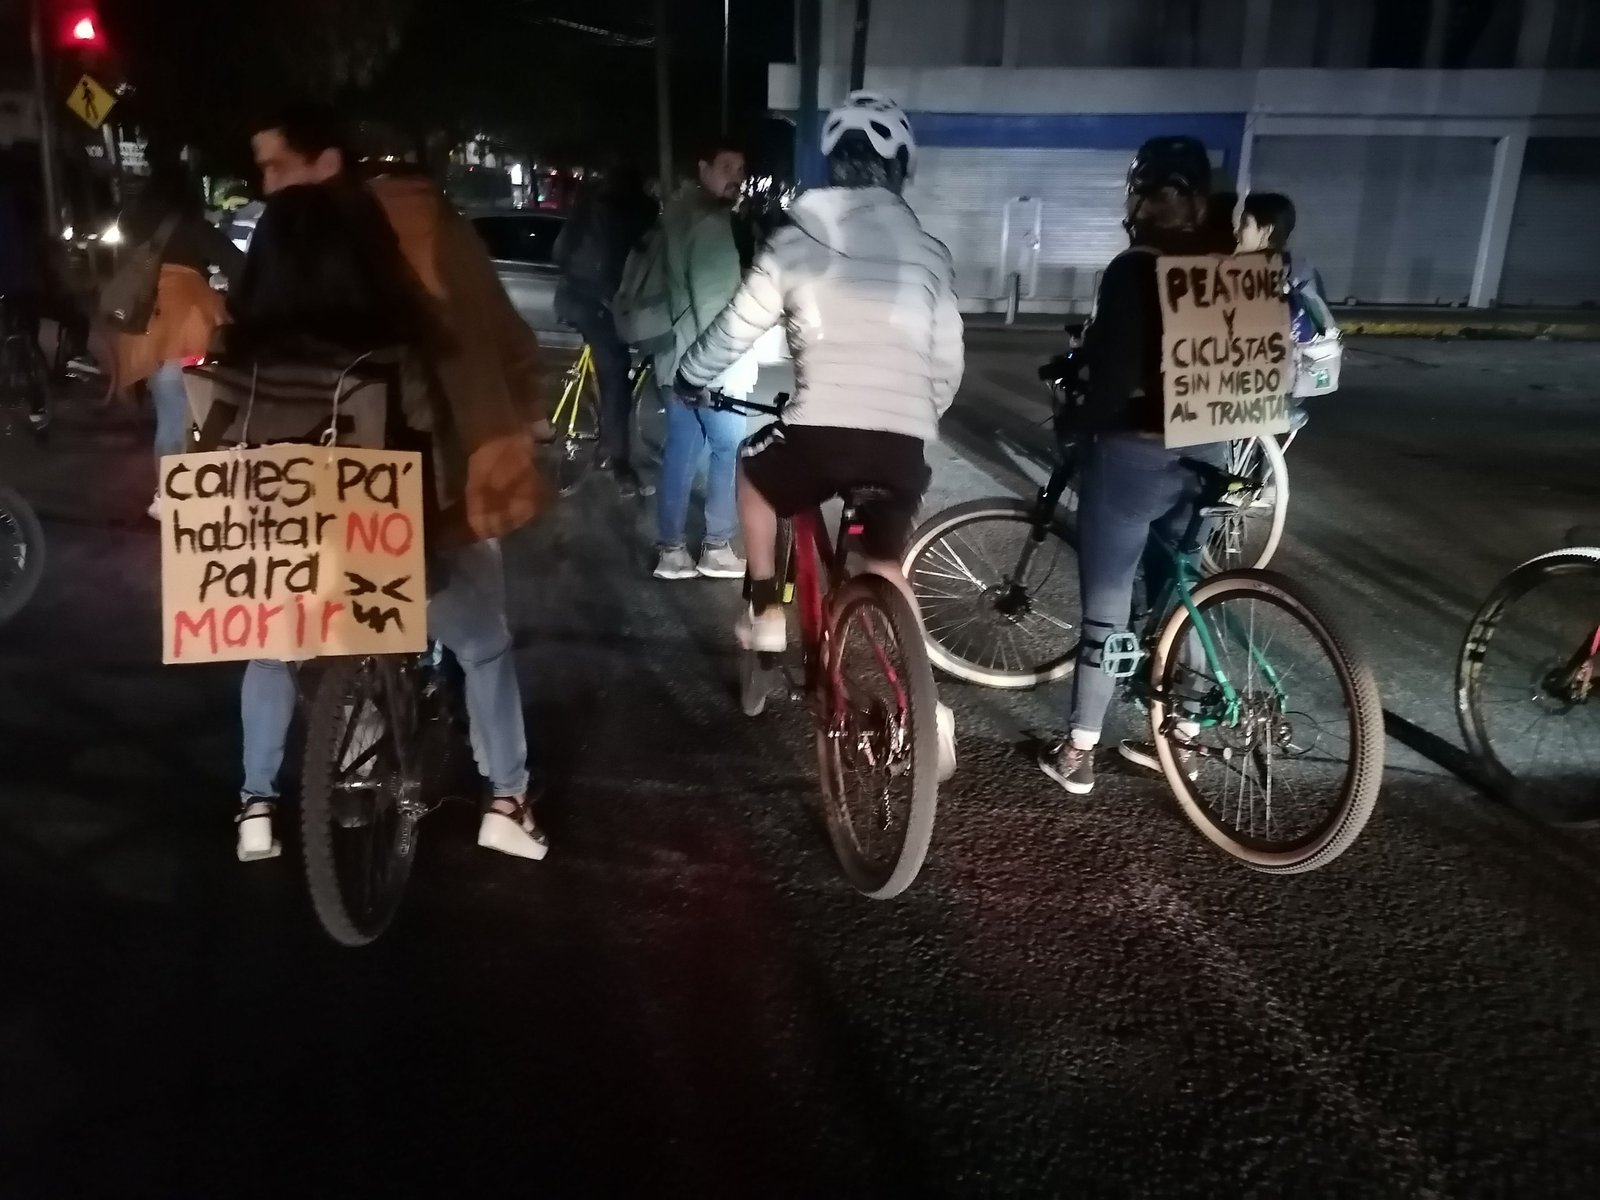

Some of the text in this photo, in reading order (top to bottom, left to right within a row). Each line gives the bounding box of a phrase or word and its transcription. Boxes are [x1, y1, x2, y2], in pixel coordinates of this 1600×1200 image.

[1223, 307, 1236, 341] Y
[1174, 368, 1280, 396] SIN MIEDO
[1169, 402, 1198, 424] AL
[173, 504, 414, 557] habitar NO
[198, 551, 320, 603] para
